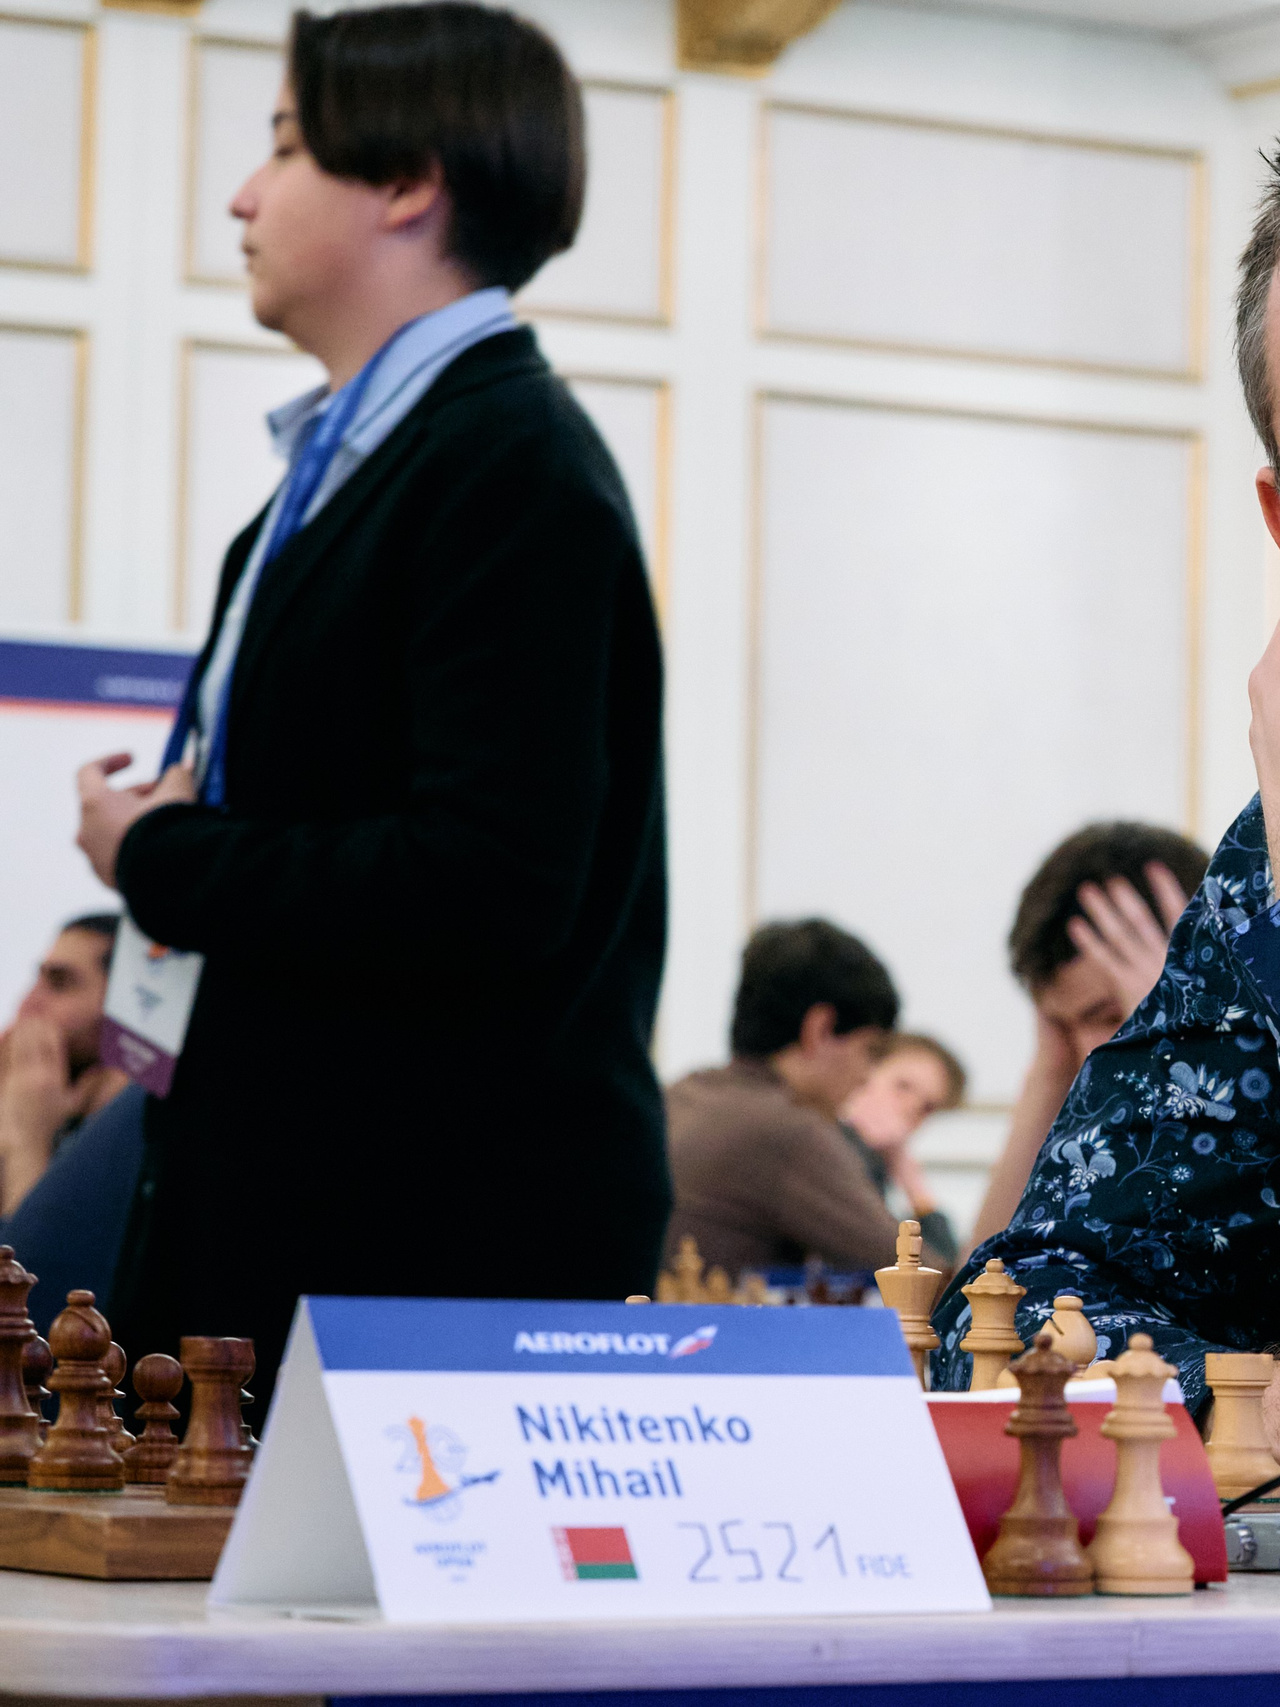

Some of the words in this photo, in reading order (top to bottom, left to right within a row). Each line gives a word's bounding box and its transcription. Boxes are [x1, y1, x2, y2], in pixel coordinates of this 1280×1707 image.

[514, 1331, 671, 1355] AEROFLOT
[515, 1403, 753, 1444] Nikitenko
[531, 1459, 684, 1498] Mihail
[677, 1518, 849, 1583] 2521
